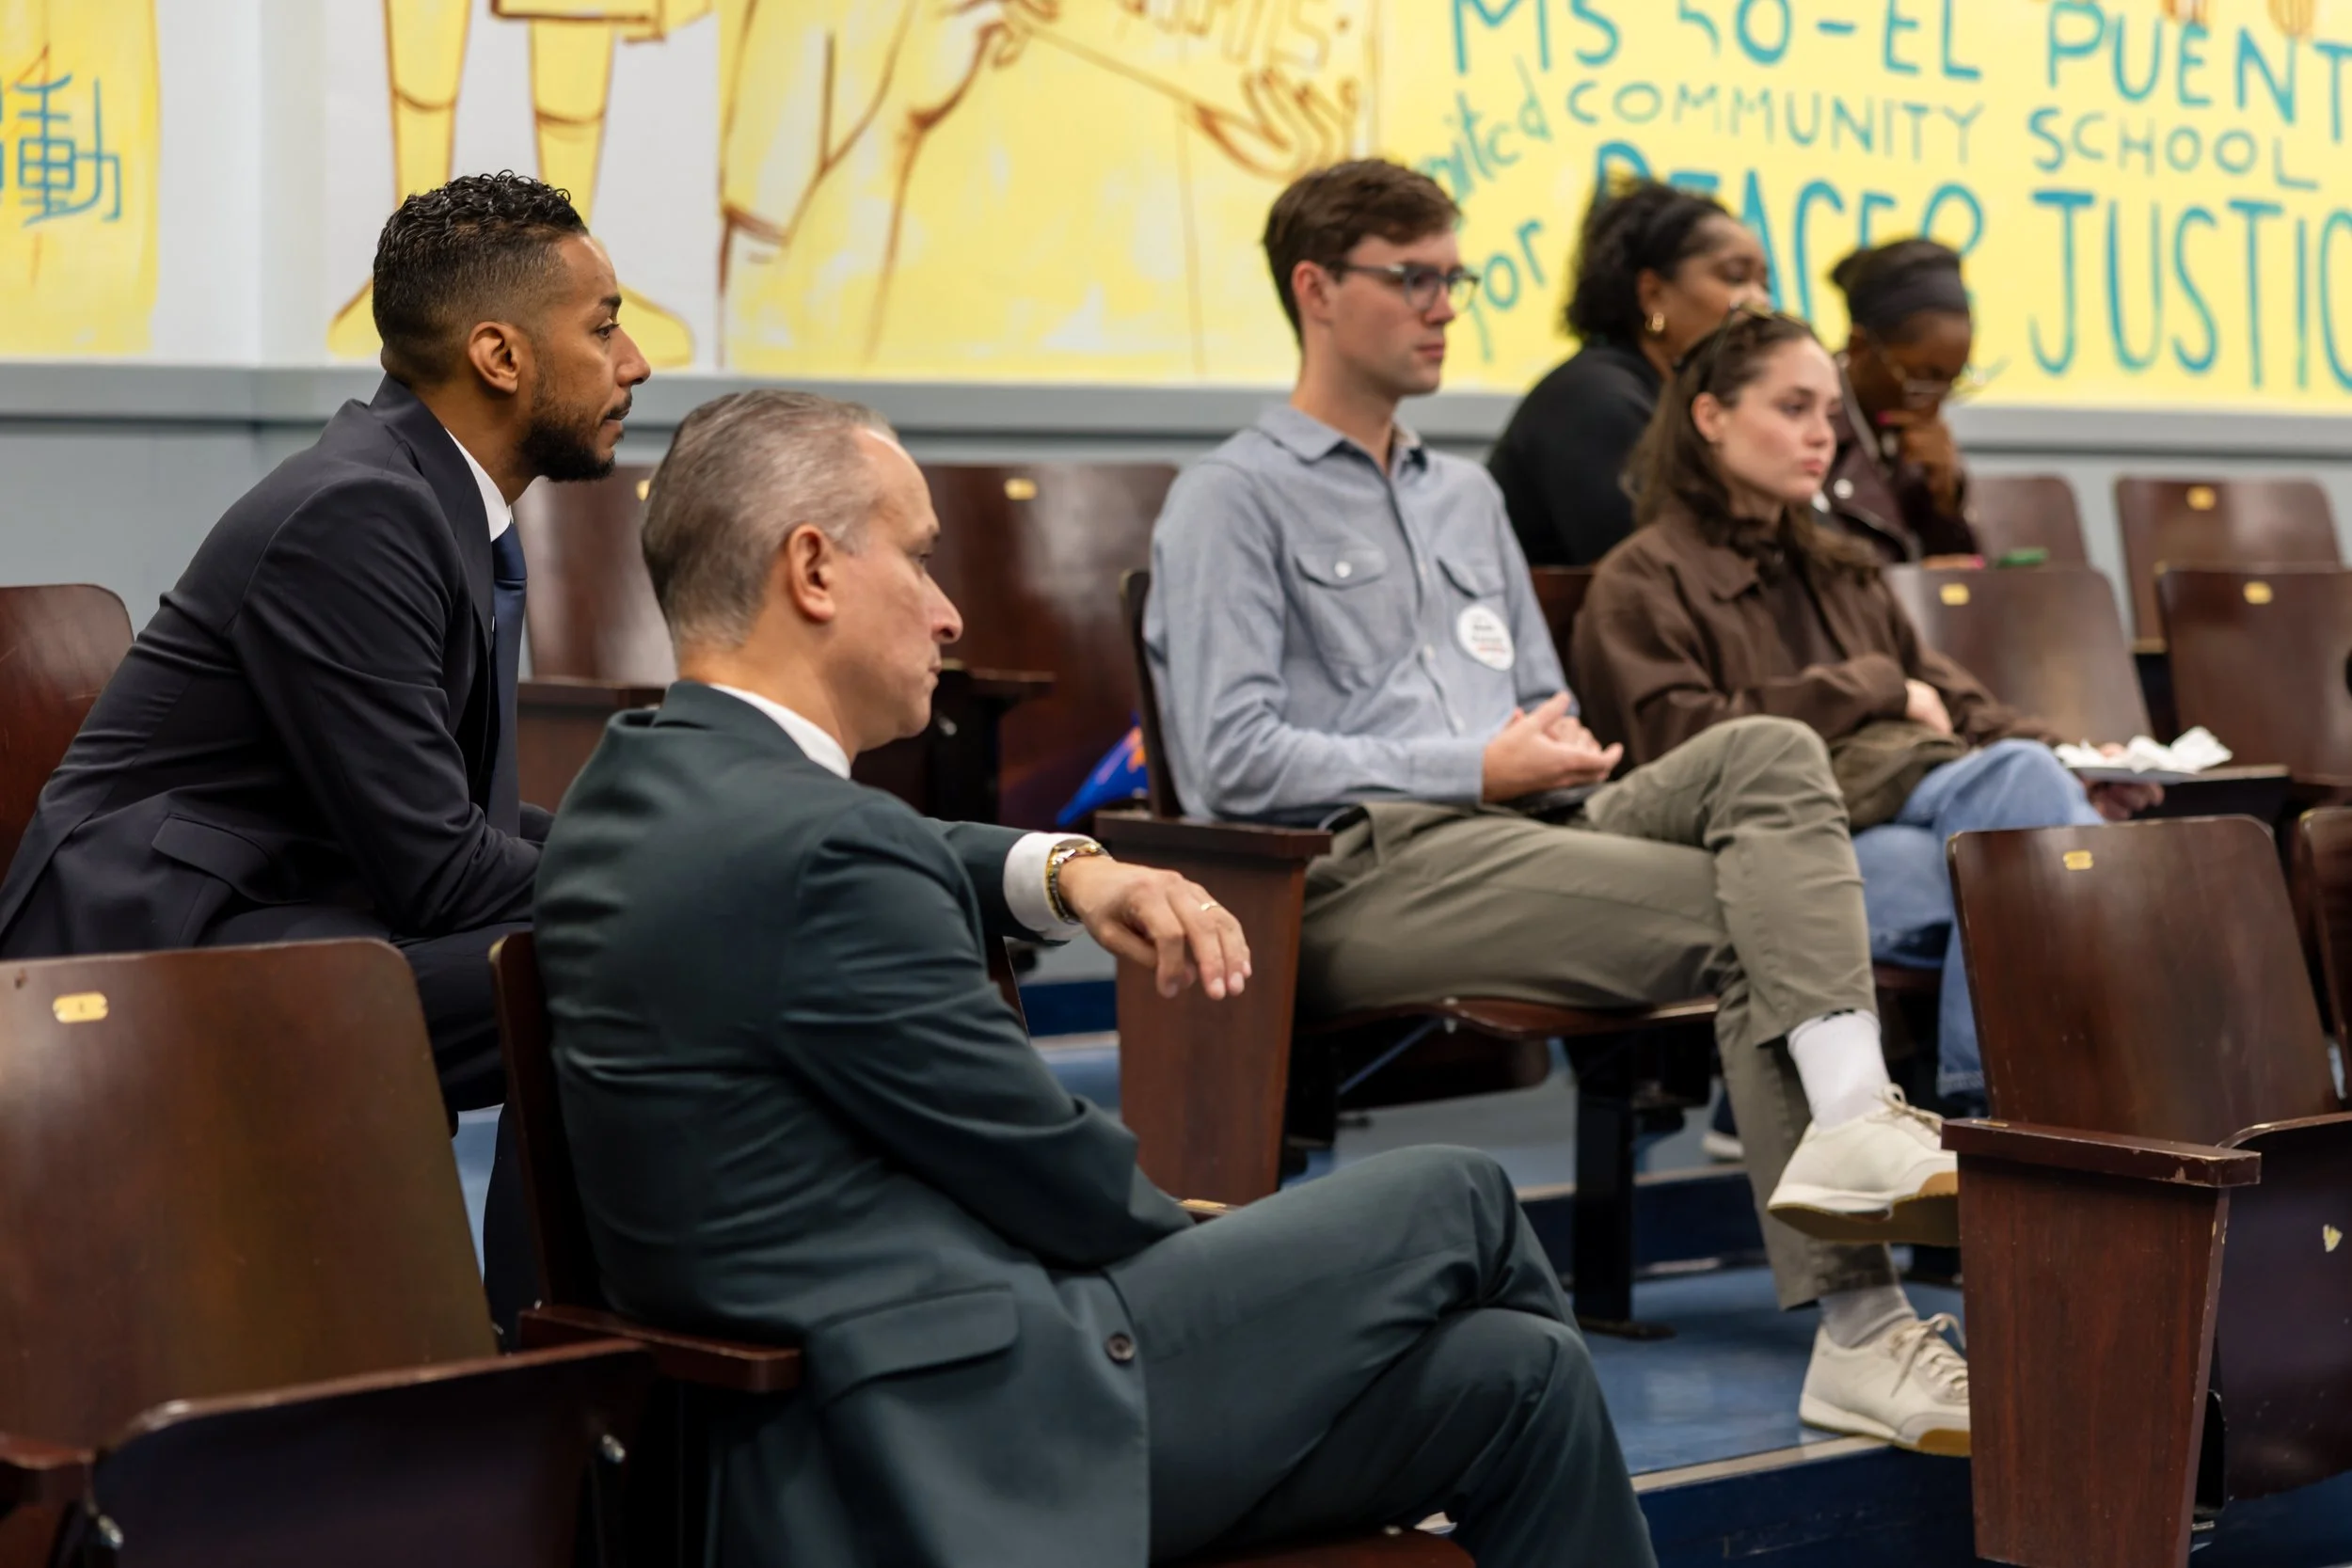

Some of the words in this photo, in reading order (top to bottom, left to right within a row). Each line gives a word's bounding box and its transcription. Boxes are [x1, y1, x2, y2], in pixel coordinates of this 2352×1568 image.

[1452, 0, 1621, 74] MS
[2045, 0, 2352, 145] PUENT
[1565, 80, 1985, 165] COMMUNITY
[2027, 106, 2322, 190] SCHOOL
